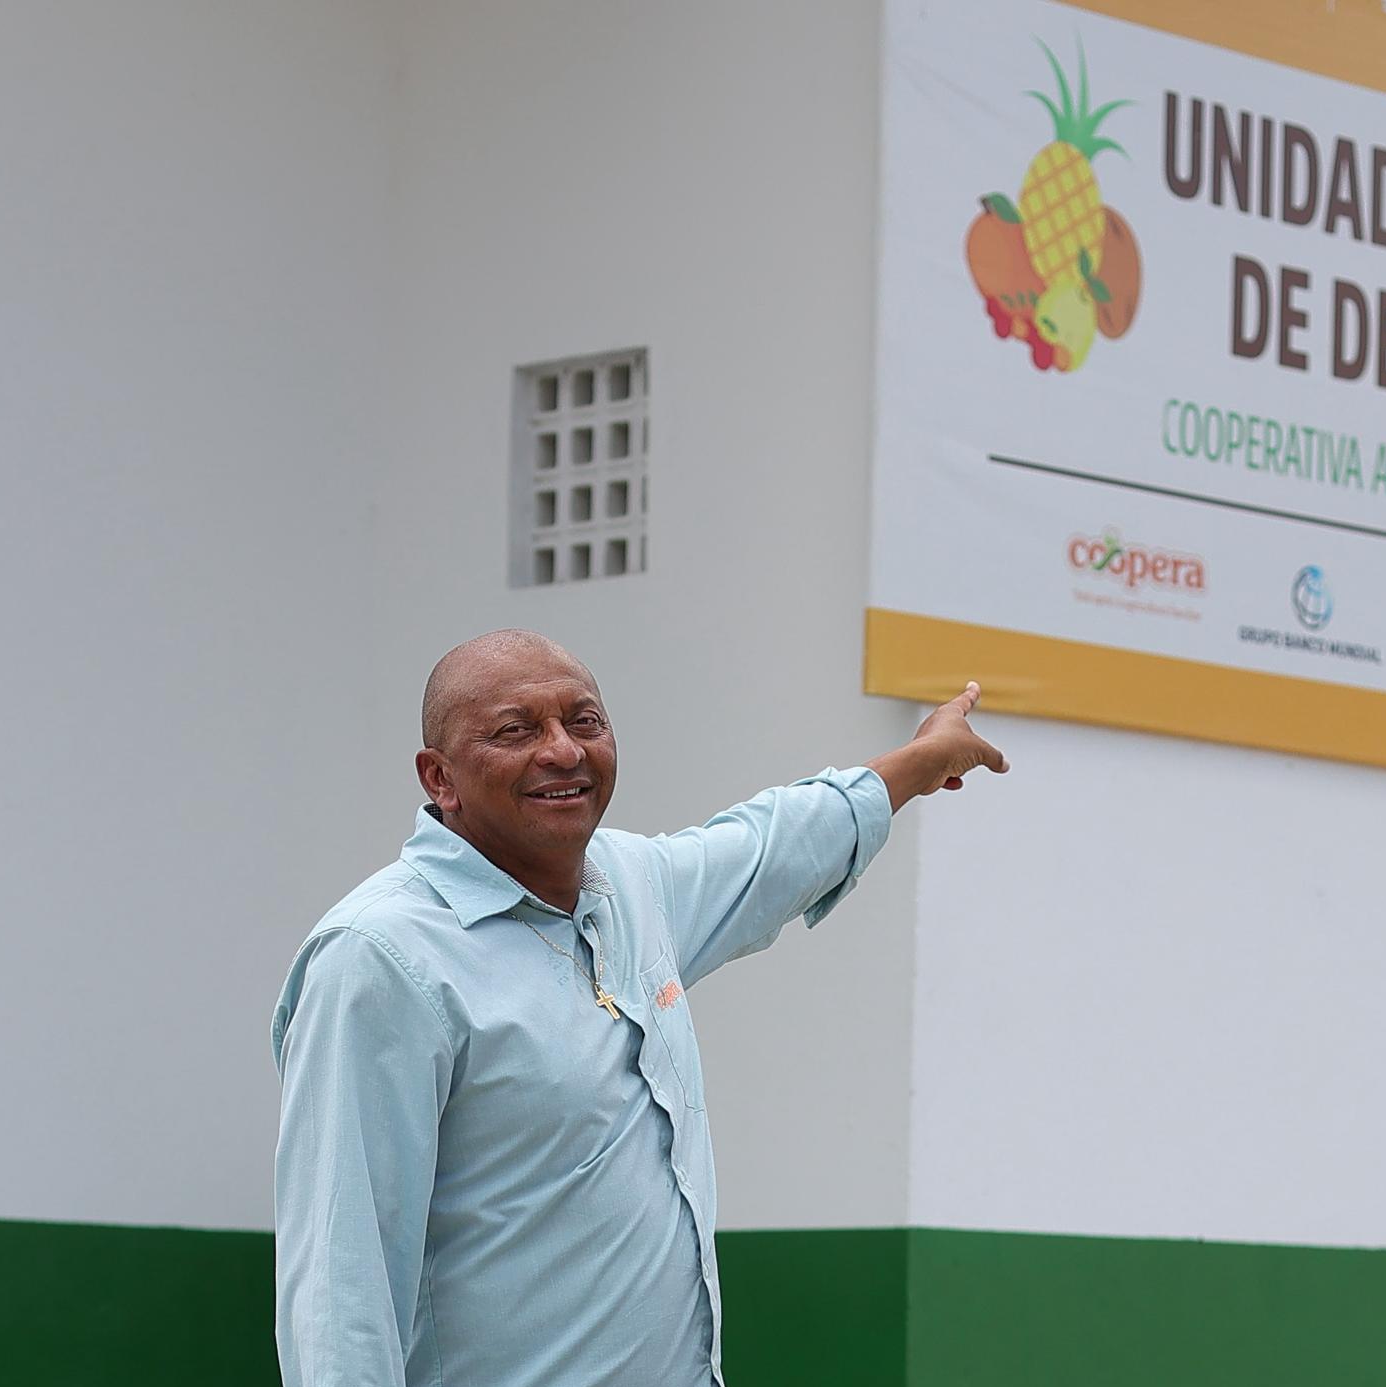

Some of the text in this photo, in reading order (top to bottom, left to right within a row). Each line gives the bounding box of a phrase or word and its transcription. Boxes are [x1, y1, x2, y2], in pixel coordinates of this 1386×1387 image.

[1231, 254, 1311, 371] DE
[1162, 398, 1364, 490] COOPERATIVA
[1068, 536, 1205, 588] coopera
[1237, 625, 1280, 648] GRUPO
[1284, 631, 1325, 654] BANCO
